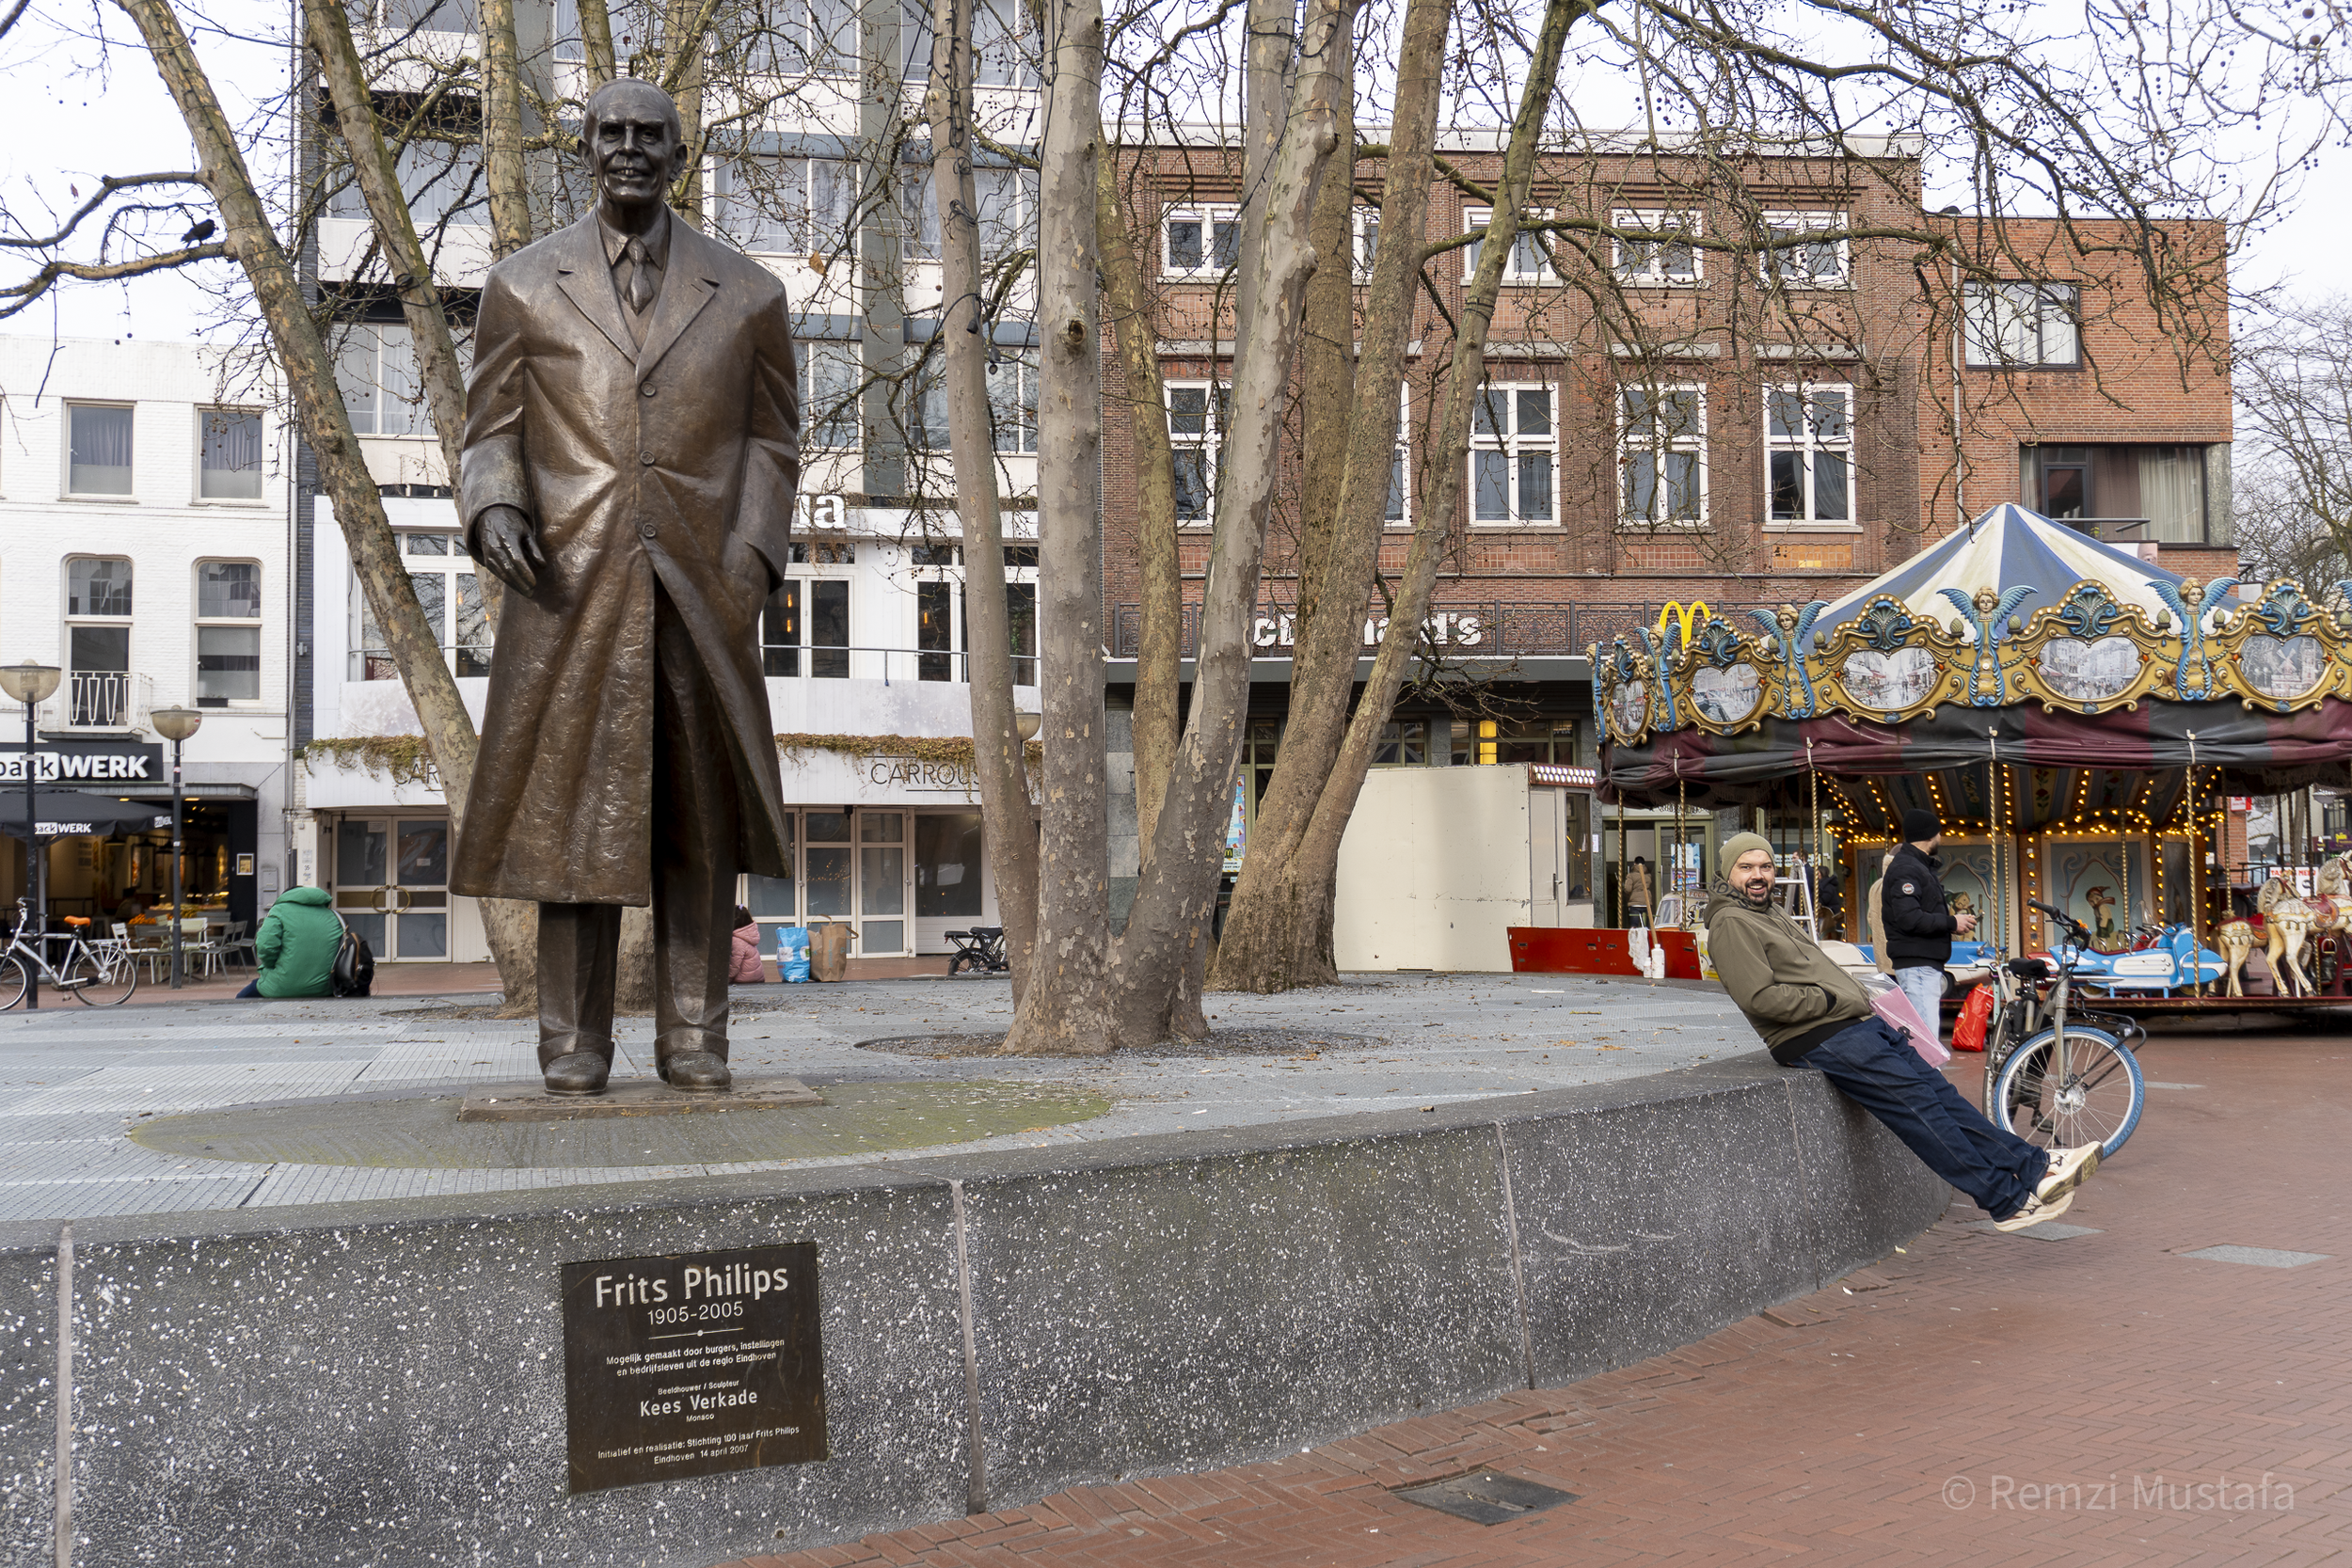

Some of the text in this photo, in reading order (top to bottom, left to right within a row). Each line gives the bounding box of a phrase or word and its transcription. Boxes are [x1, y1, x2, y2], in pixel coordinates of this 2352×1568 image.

[596, 1262, 788, 1307] Frits Philips
[647, 1301, 743, 1325] 1905-2005
[606, 1338, 785, 1366] Mogelijk gemaakt door burgers, instellingen
[616, 1352, 776, 1377] en bedrijfsleven uit de regio Eindhoven
[658, 1384, 702, 1395] Beeldhouwer
[708, 1380, 739, 1390] Sculpteur
[640, 1388, 757, 1418] Kees Verkade
[686, 1413, 715, 1422] Monaco
[597, 1426, 800, 1459] Initiatief en realisatie: Stichting 100 jaar Frits Philips
[654, 1444, 749, 1465] Eindhoven 14 april 2007
